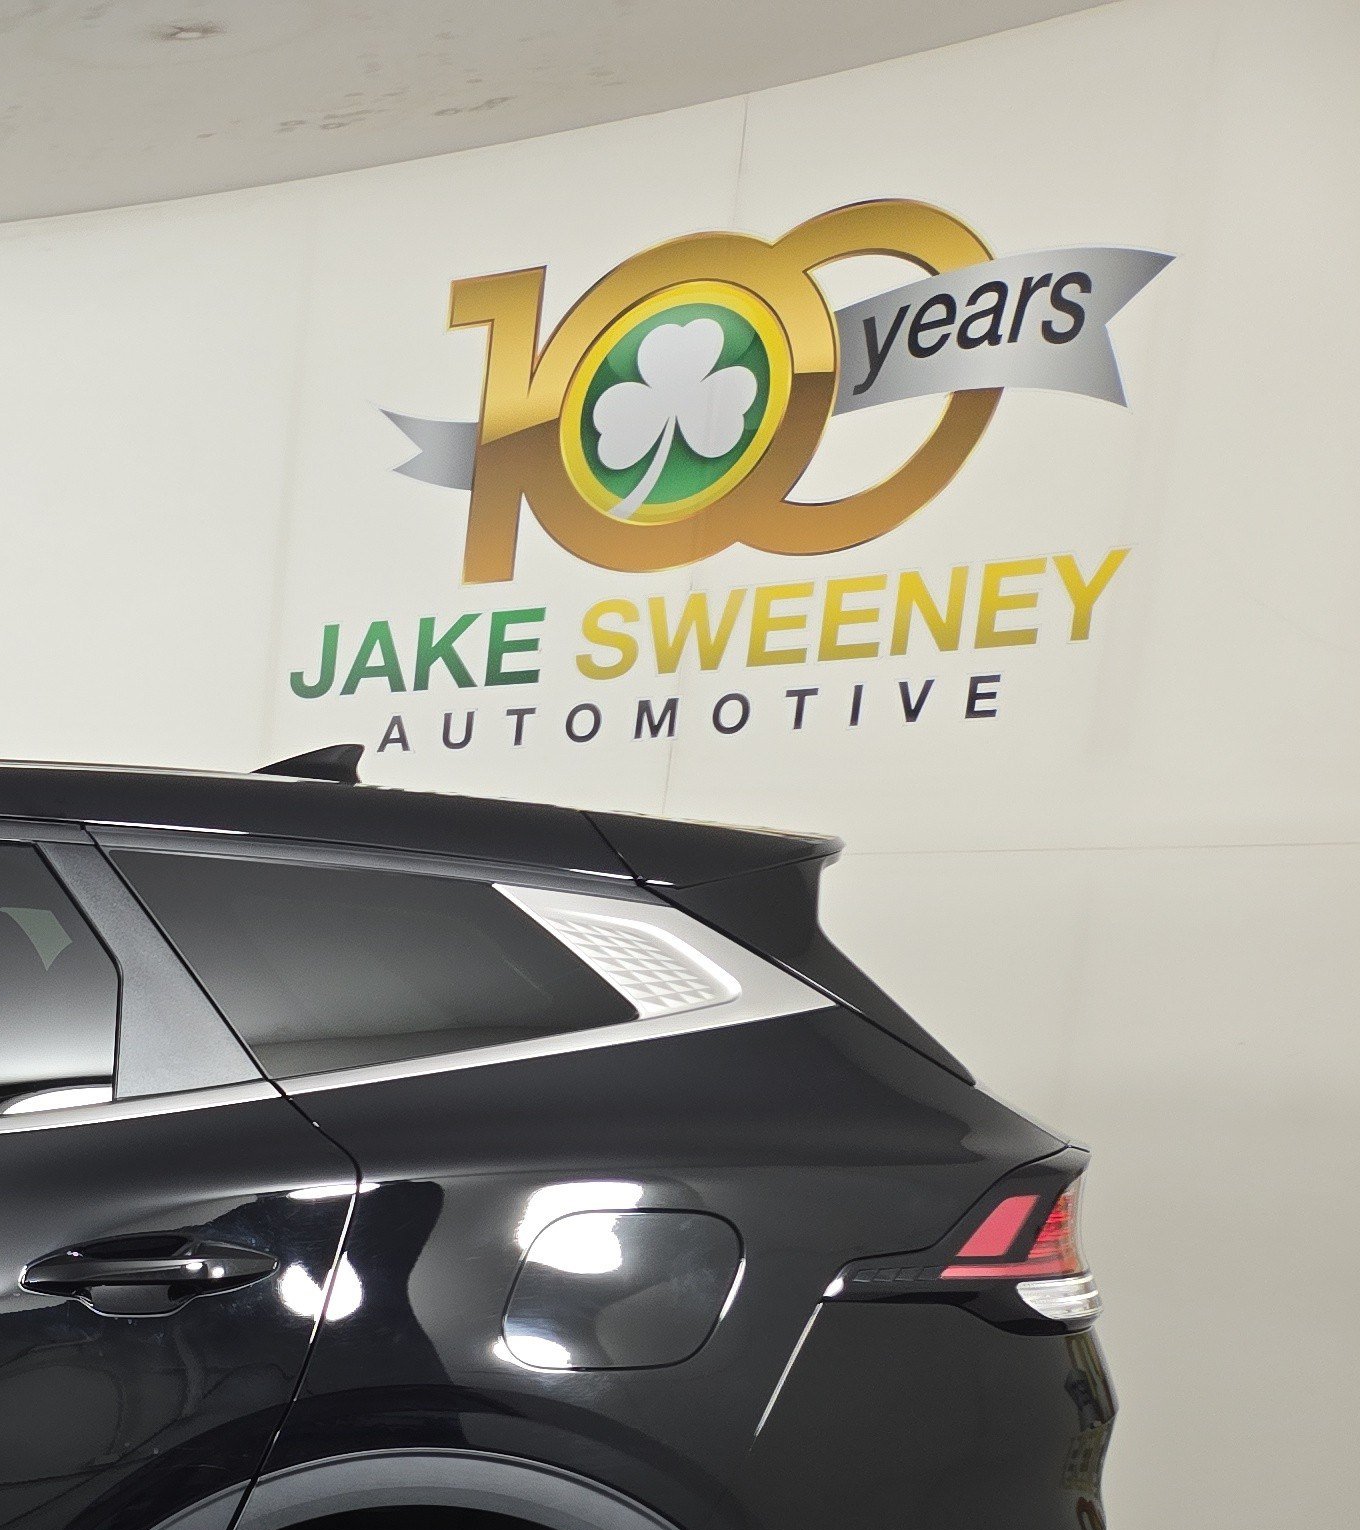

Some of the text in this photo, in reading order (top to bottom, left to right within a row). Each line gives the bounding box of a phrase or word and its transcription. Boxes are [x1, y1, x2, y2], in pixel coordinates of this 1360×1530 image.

[852, 270, 1092, 395] years
[289, 548, 1131, 698] JAKE SWEENEY
[378, 674, 1002, 753] AUTOMOTIVE
